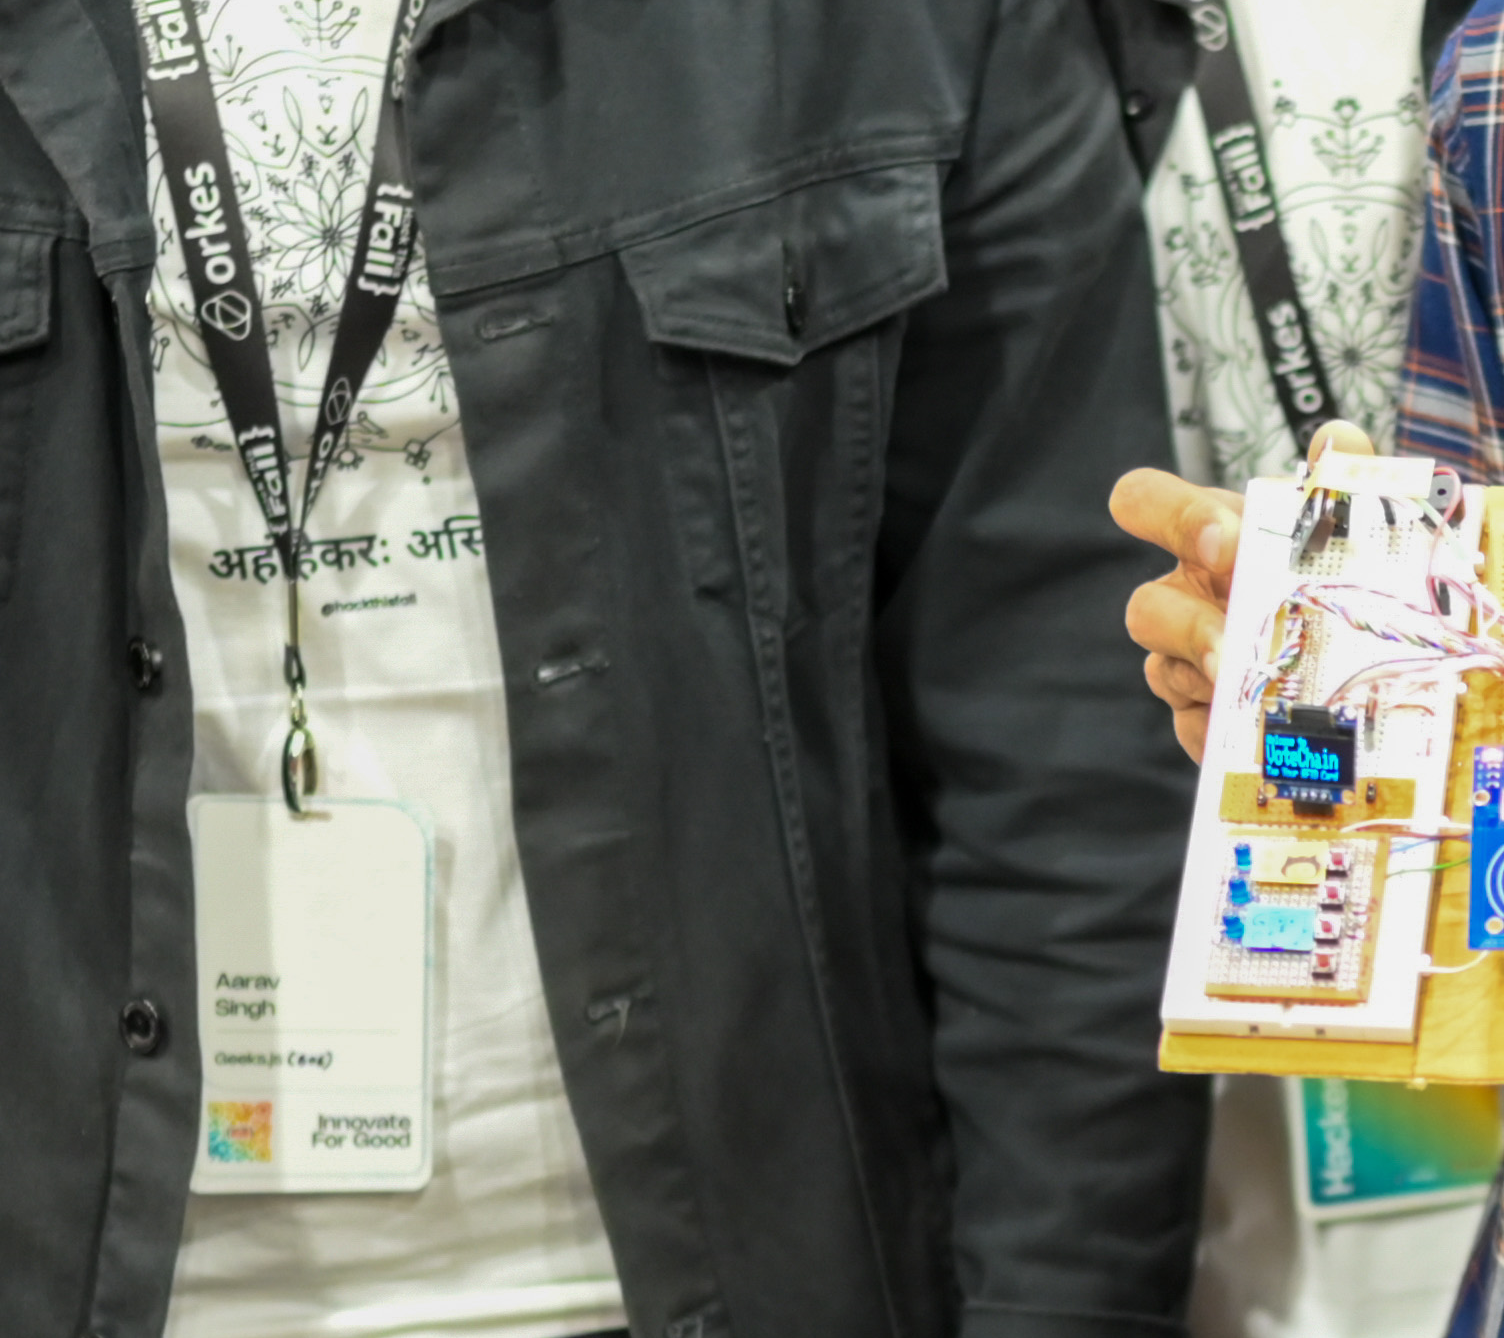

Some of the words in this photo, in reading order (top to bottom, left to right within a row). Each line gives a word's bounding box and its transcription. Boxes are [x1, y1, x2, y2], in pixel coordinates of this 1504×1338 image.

[184, 162, 236, 284] orkes
[1266, 301, 1323, 414] orkes
[321, 593, 417, 617] @hackthisfall
[216, 973, 280, 990] Aarav
[215, 999, 276, 1020] Singh
[318, 1114, 411, 1130] Innovate
[312, 1133, 346, 1148] For
[353, 1133, 411, 1148] Good
[1318, 1079, 1354, 1196] Hacke
